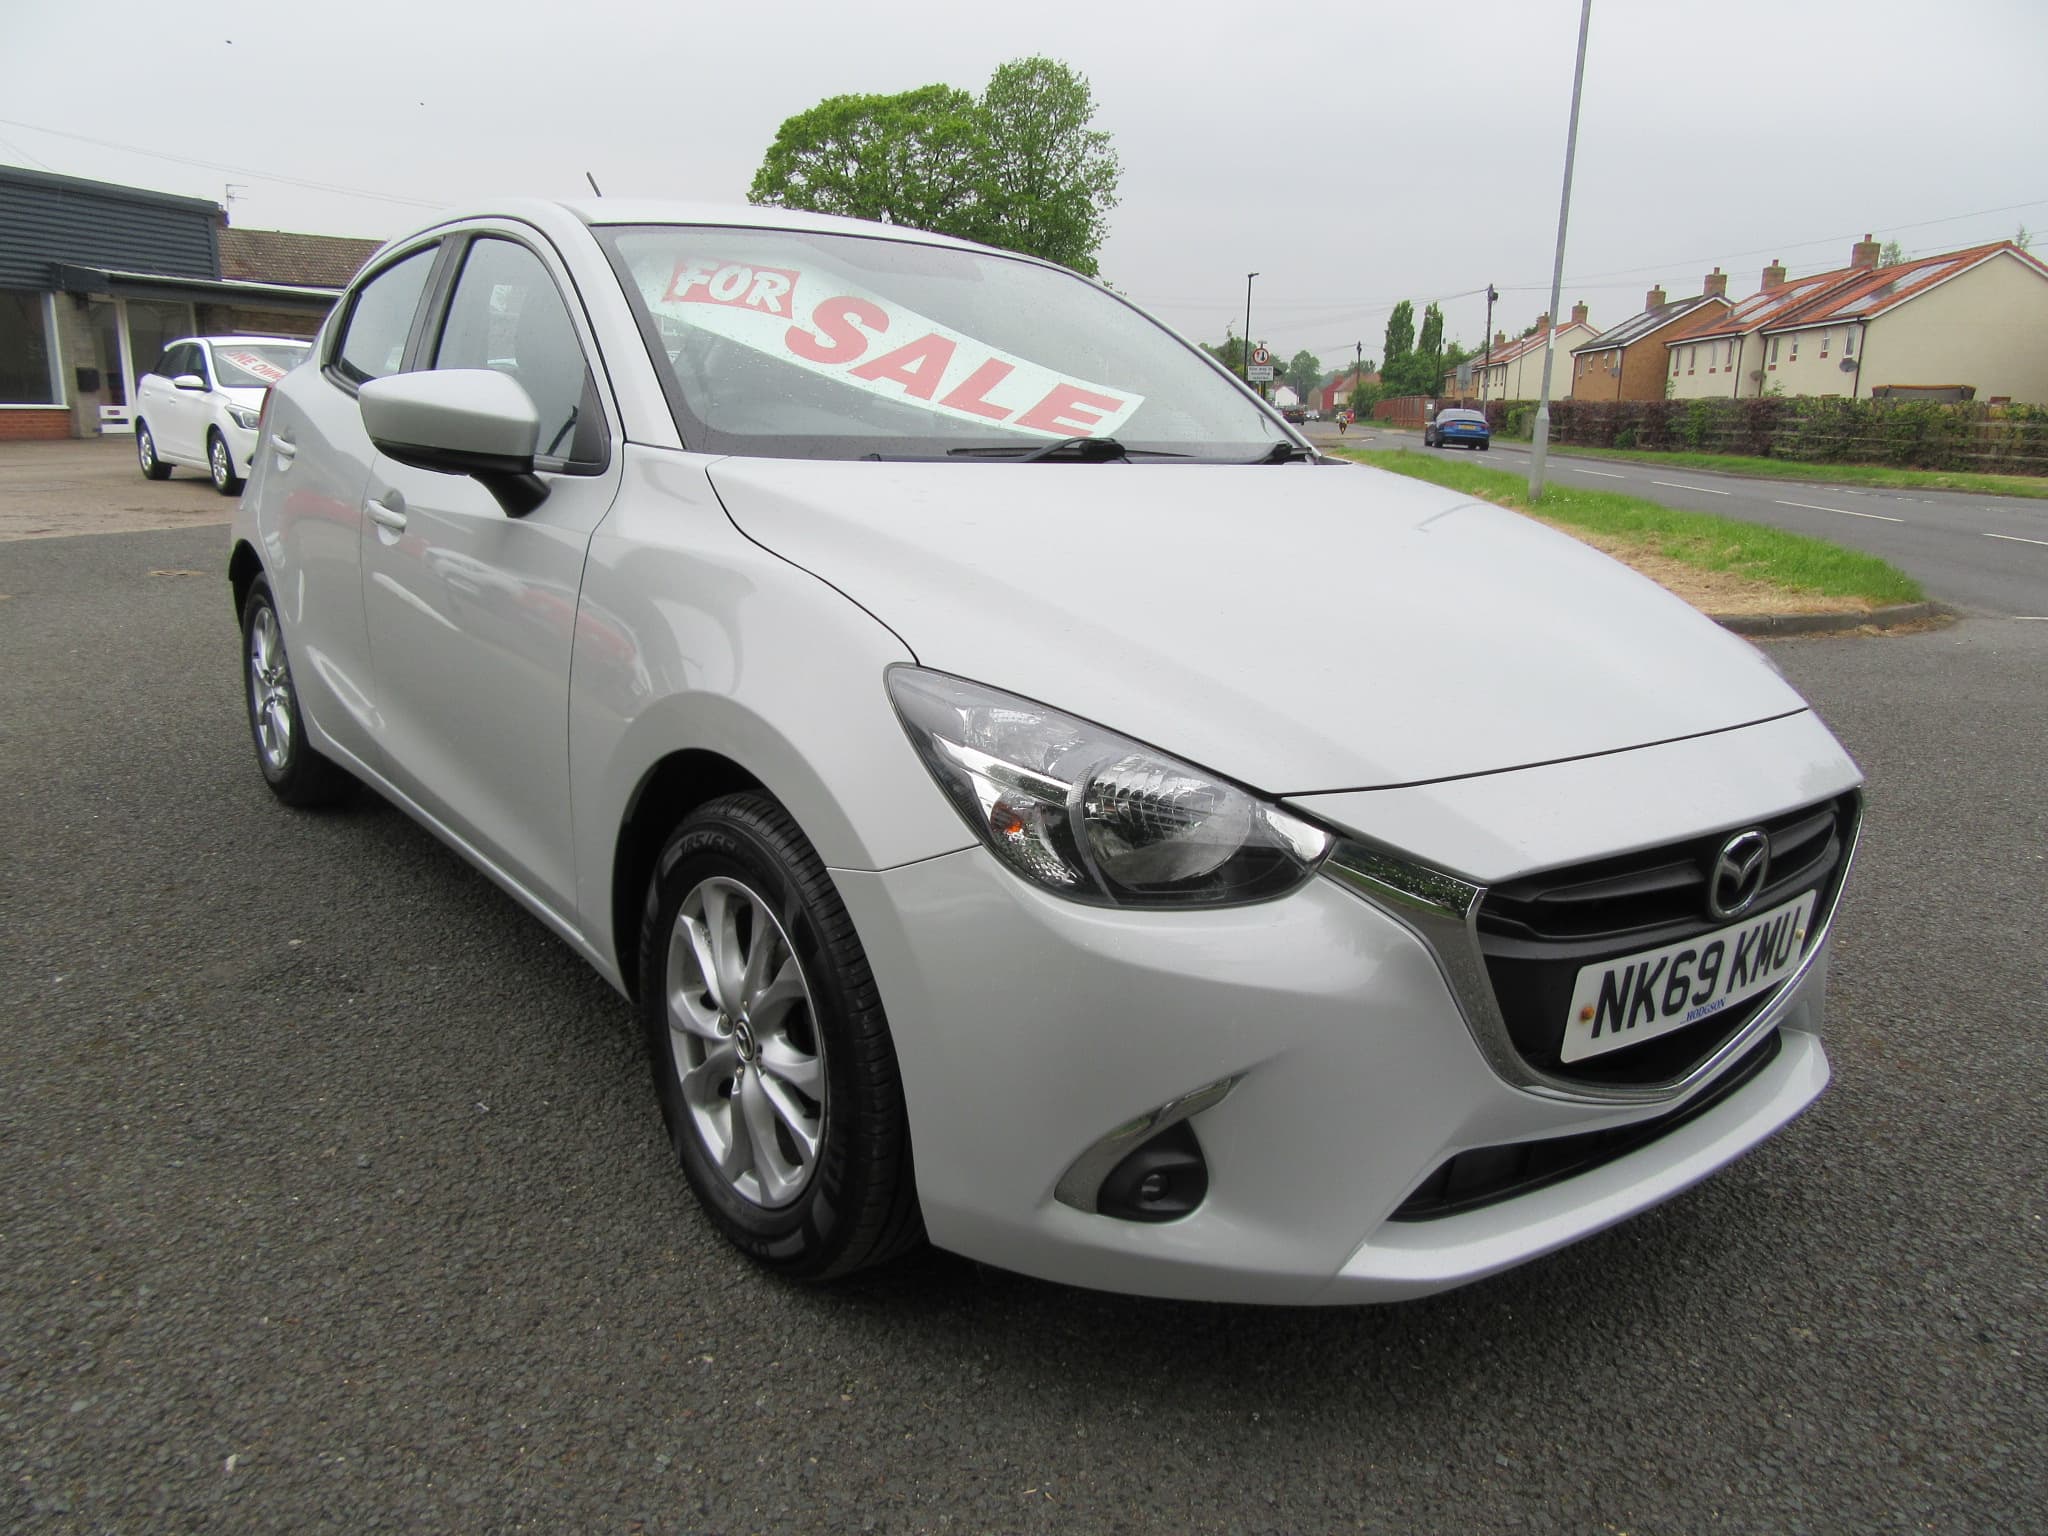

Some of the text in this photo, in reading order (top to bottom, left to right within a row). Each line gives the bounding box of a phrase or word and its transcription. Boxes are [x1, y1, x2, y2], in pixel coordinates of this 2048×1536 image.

[672, 256, 1126, 438] FOR SALE
[1590, 905, 1802, 1040] NK69 KMU
